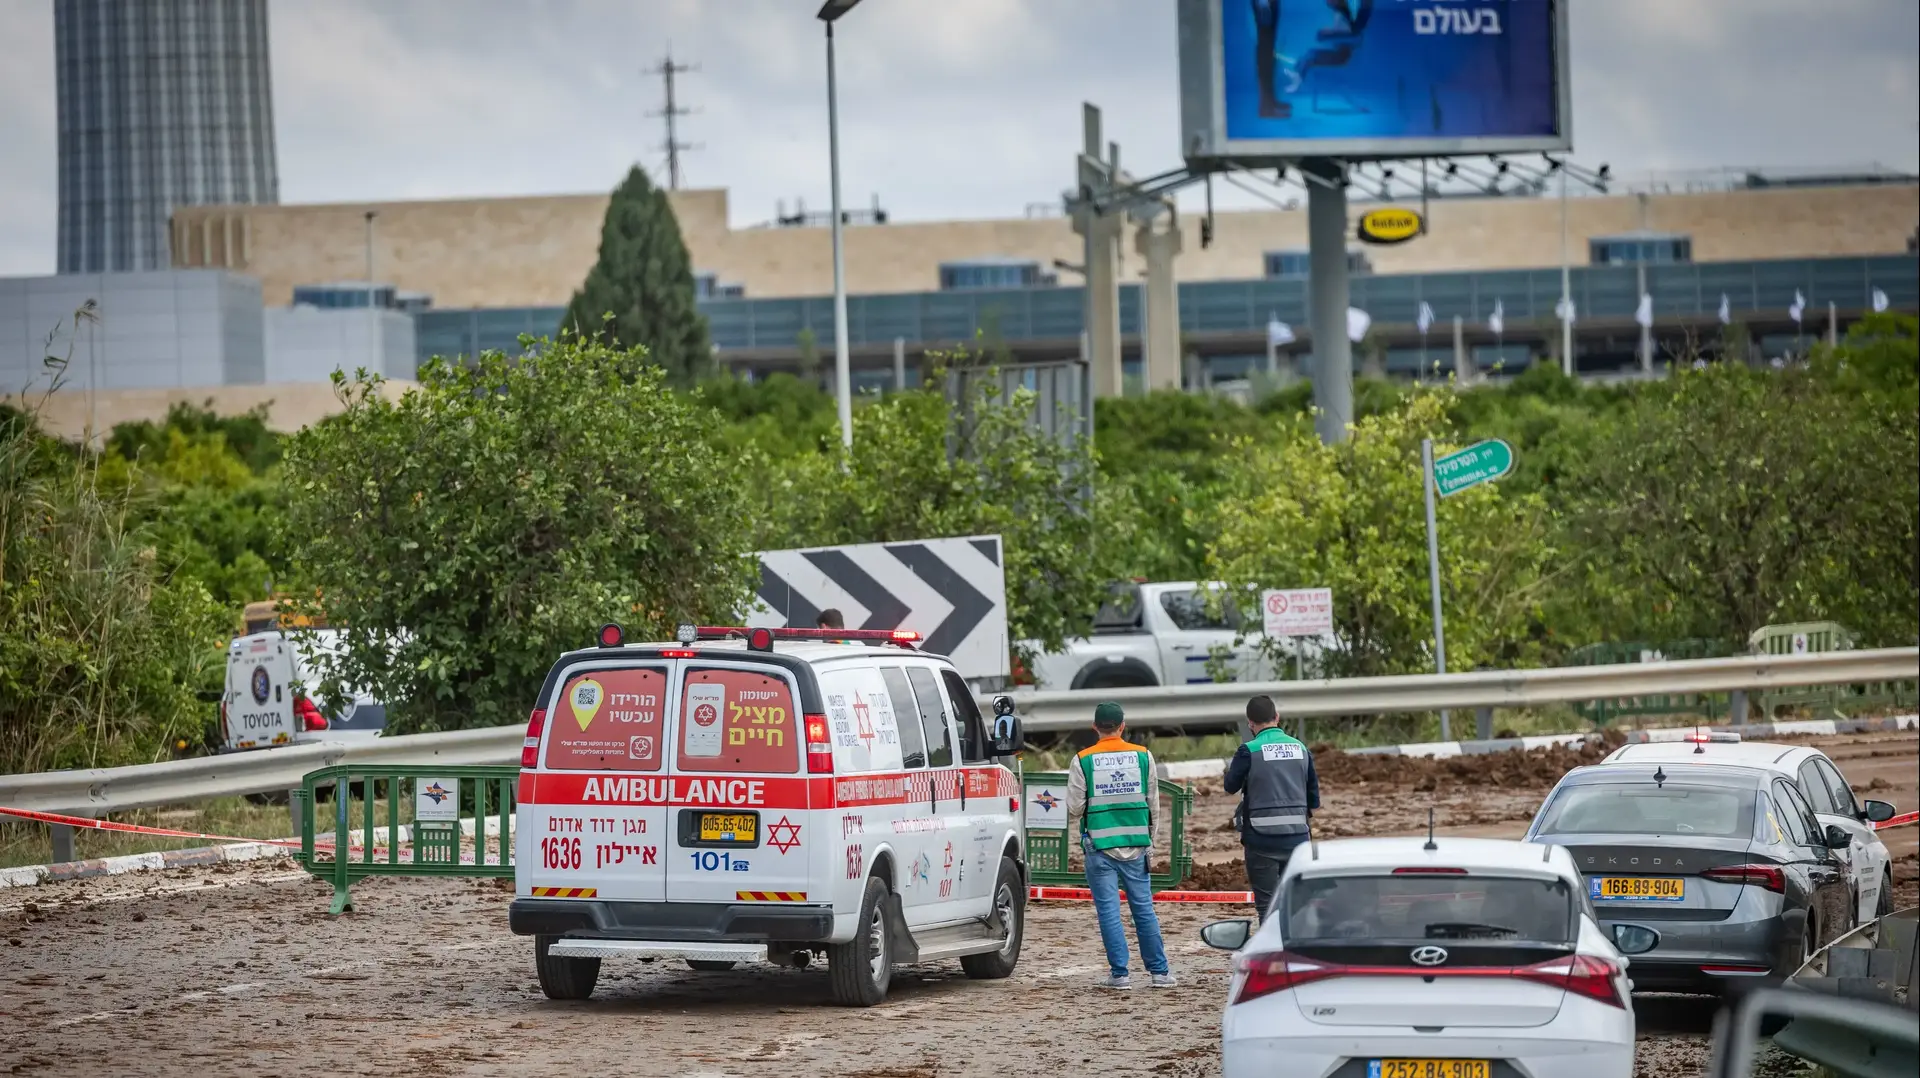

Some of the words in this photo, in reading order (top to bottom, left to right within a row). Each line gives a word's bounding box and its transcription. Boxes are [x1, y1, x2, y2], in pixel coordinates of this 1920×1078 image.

[1413, 5, 1502, 35] בעולם
[611, 694, 655, 707] הורידו
[740, 690, 778, 702] יישומון
[242, 712, 283, 729] TOYOTA
[609, 711, 654, 723] עכשיו
[729, 701, 785, 724] מציל
[729, 727, 784, 747] חיים
[582, 777, 765, 805] AMBULANCE
[1101, 787, 1136, 795] INSPECTOR
[549, 815, 583, 832] אדום
[589, 818, 615, 833] דוד
[622, 818, 647, 836] מגן
[541, 837, 582, 870] 1636
[596, 841, 657, 869] איילון
[690, 851, 730, 871] 101
[846, 843, 863, 880] 1636
[1587, 856, 1684, 866] SKODA
[939, 878, 953, 898] 101
